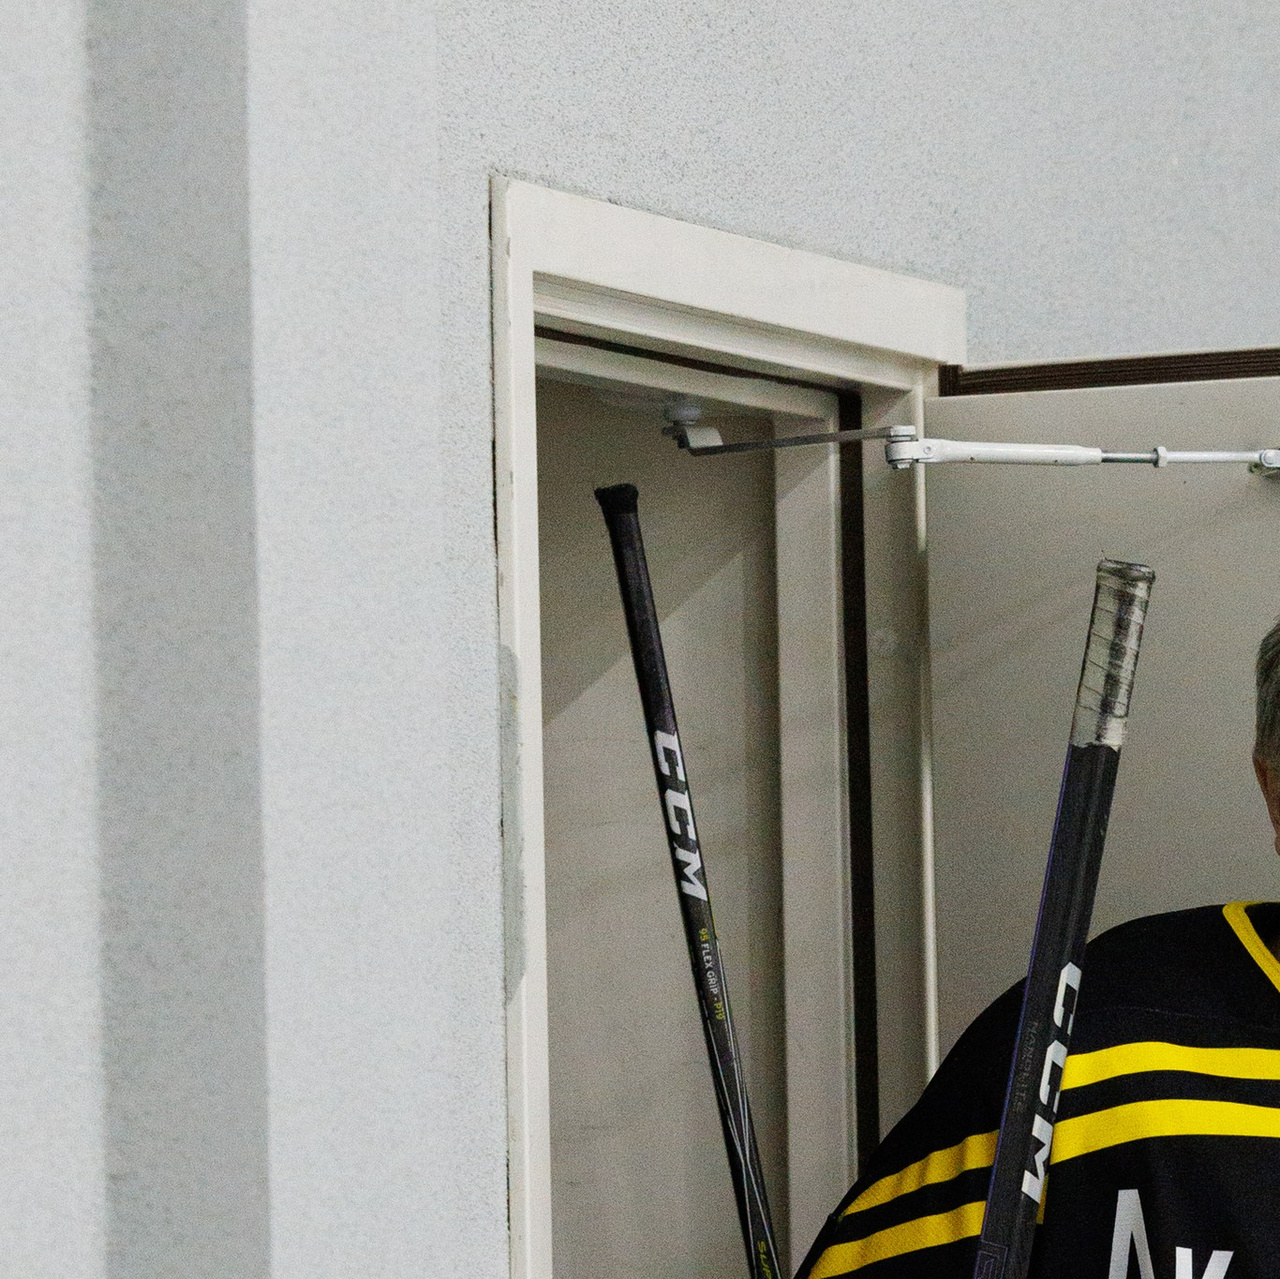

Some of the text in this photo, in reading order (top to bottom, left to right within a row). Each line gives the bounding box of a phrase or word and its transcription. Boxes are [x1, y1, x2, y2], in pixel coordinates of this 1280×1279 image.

[654, 730, 708, 901] CCM
[701, 943, 714, 969] FLEX
[706, 970, 719, 995] GRIP
[1021, 962, 1083, 1204] CCM
